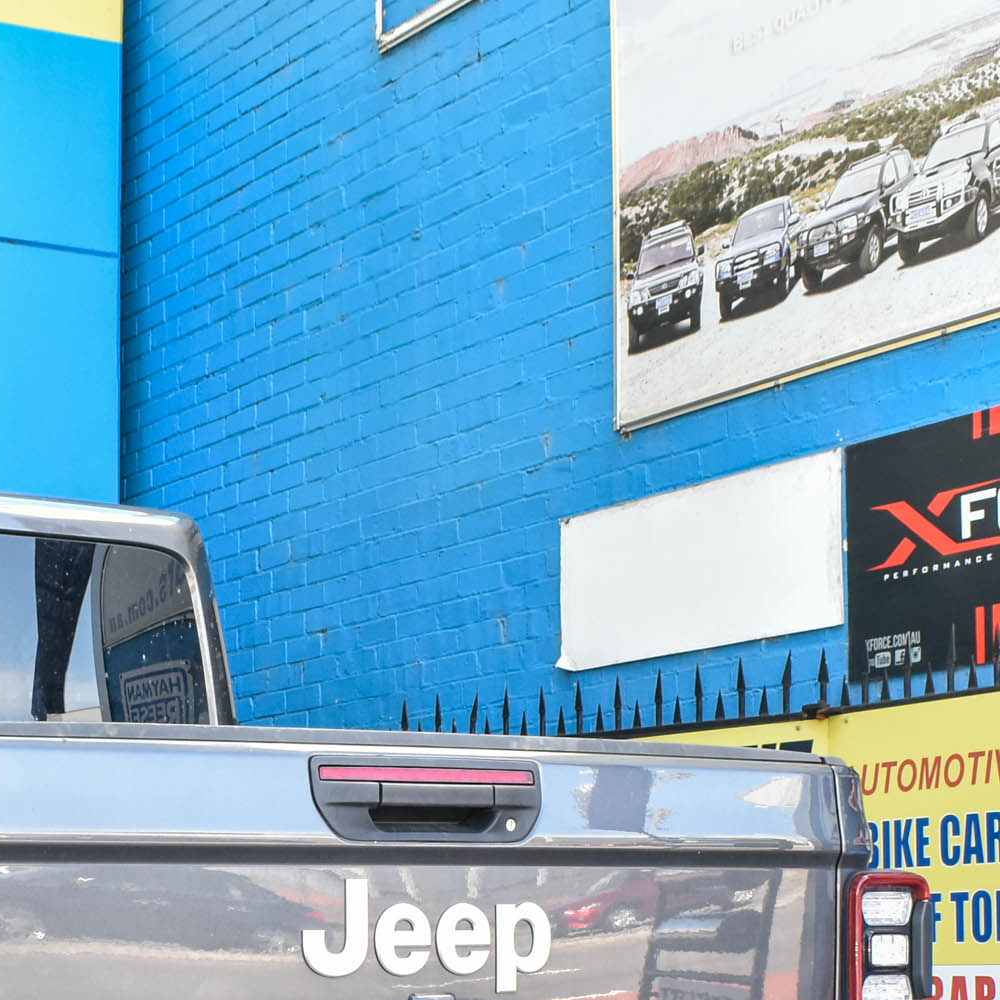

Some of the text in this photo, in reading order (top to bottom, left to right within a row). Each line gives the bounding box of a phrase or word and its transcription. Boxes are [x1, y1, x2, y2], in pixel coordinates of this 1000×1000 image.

[867, 478, 1000, 572] XF
[883, 553, 993, 581] PERFORMANCE
[865, 630, 921, 652] XFORCE.COMAU
[861, 749, 1000, 796] UTOMOTI
[301, 878, 552, 994] Jeep
[950, 889, 1000, 943] TO
